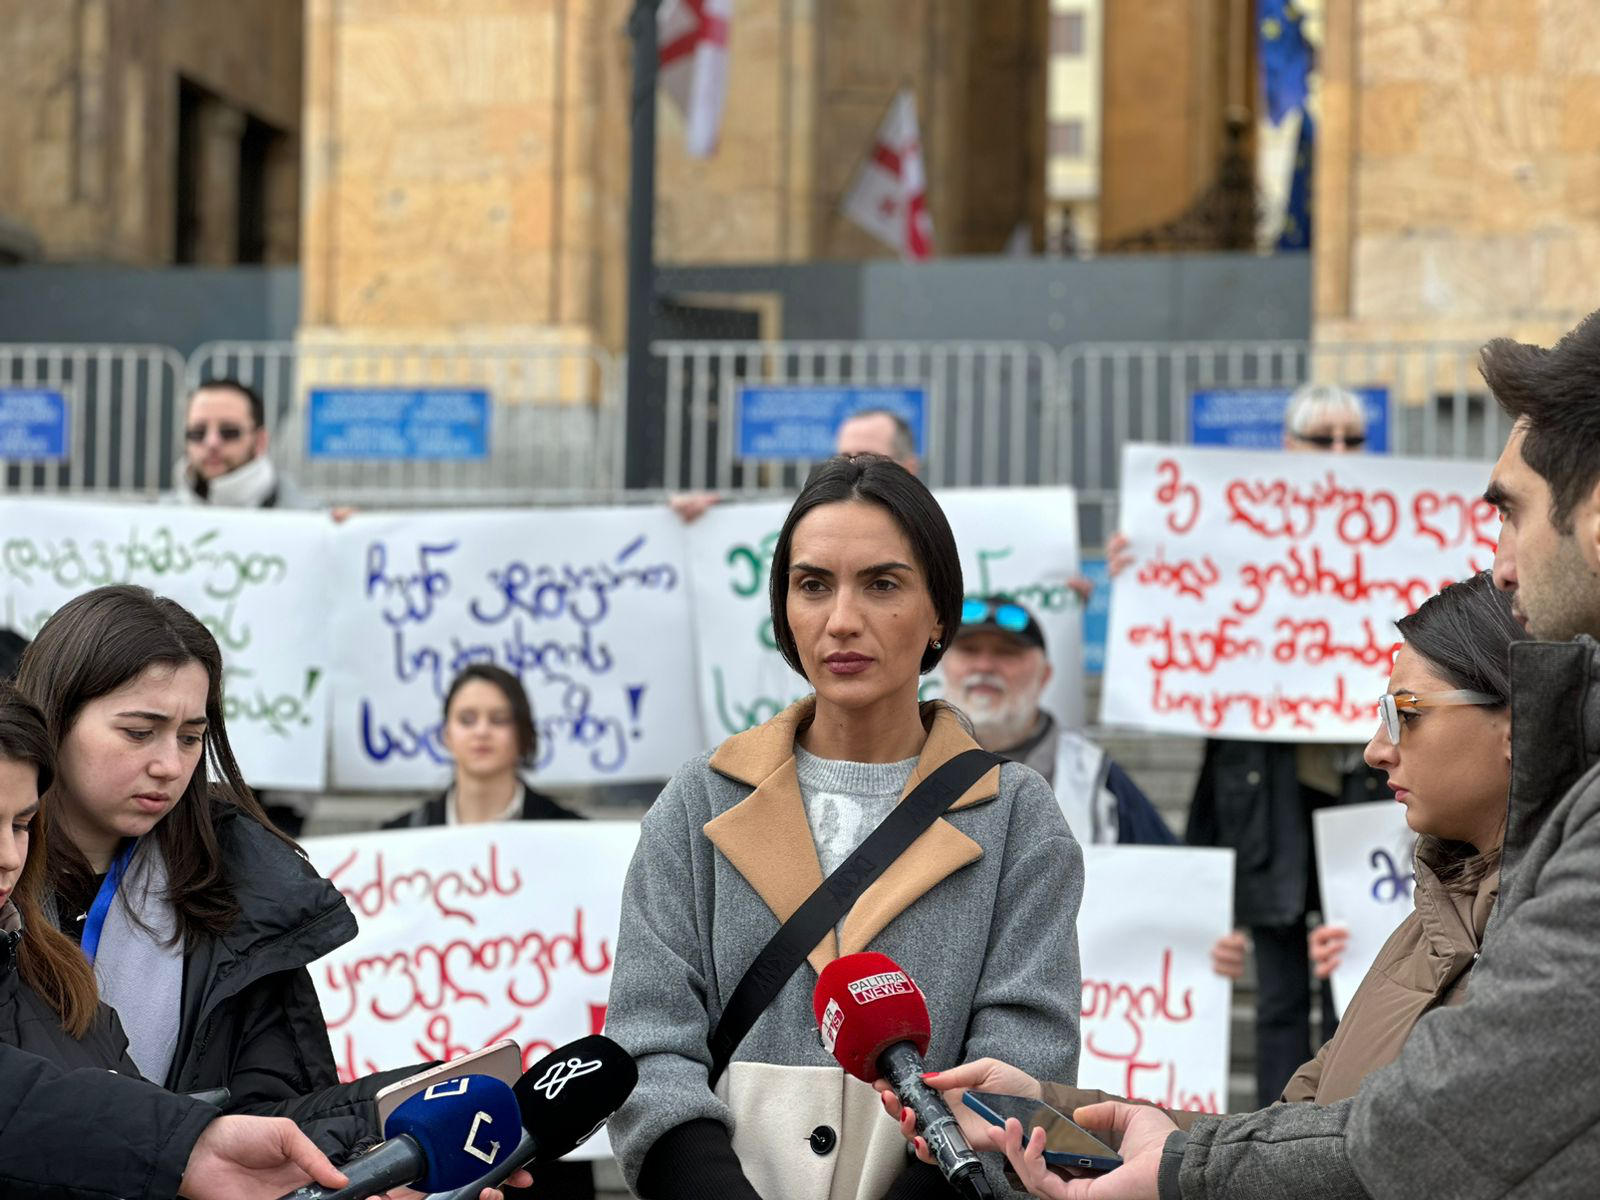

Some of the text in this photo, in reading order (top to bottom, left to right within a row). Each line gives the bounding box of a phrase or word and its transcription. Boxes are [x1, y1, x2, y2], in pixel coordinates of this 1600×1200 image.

[1155, 459, 1201, 534] მე
[1411, 490, 1499, 562] დედ
[364, 538, 460, 625] ჩვენ
[328, 843, 523, 926] რძოლას
[325, 906, 613, 1029] ყოველთვის
[850, 972, 904, 993] PALITRA
[862, 985, 906, 1003] NEWS
